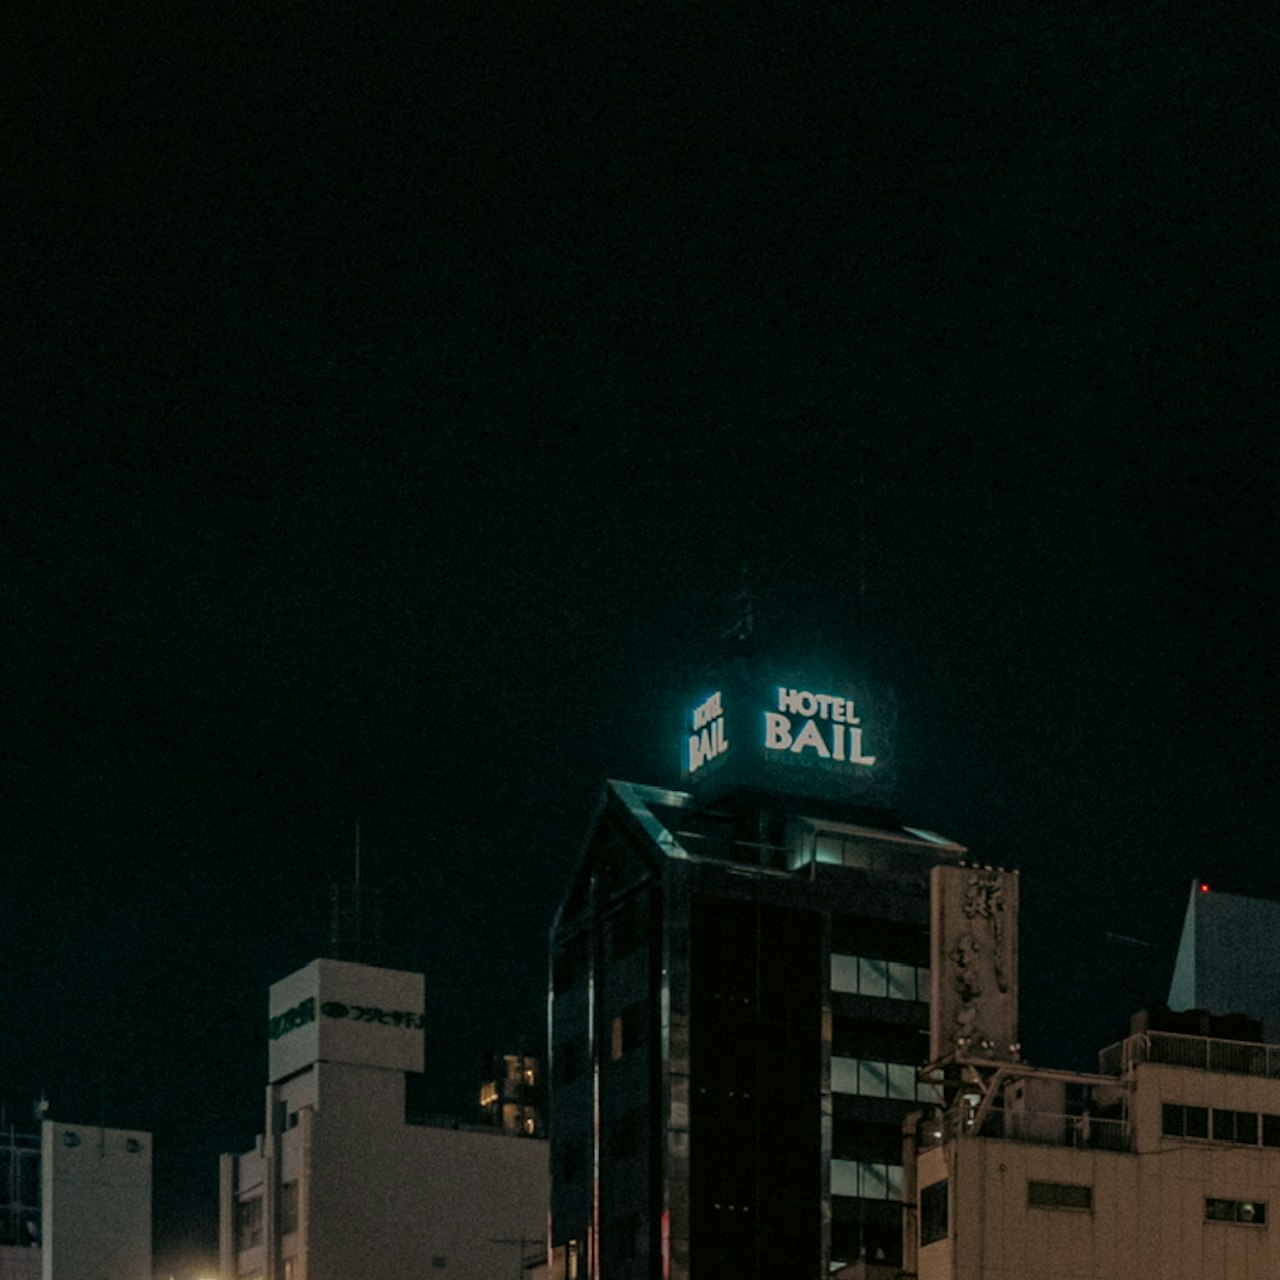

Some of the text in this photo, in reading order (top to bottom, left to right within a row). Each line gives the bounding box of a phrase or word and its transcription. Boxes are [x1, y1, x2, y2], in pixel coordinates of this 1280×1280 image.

[778, 686, 861, 725] HOTEL
[688, 716, 730, 774] BAIL
[764, 711, 877, 766] BAIL
